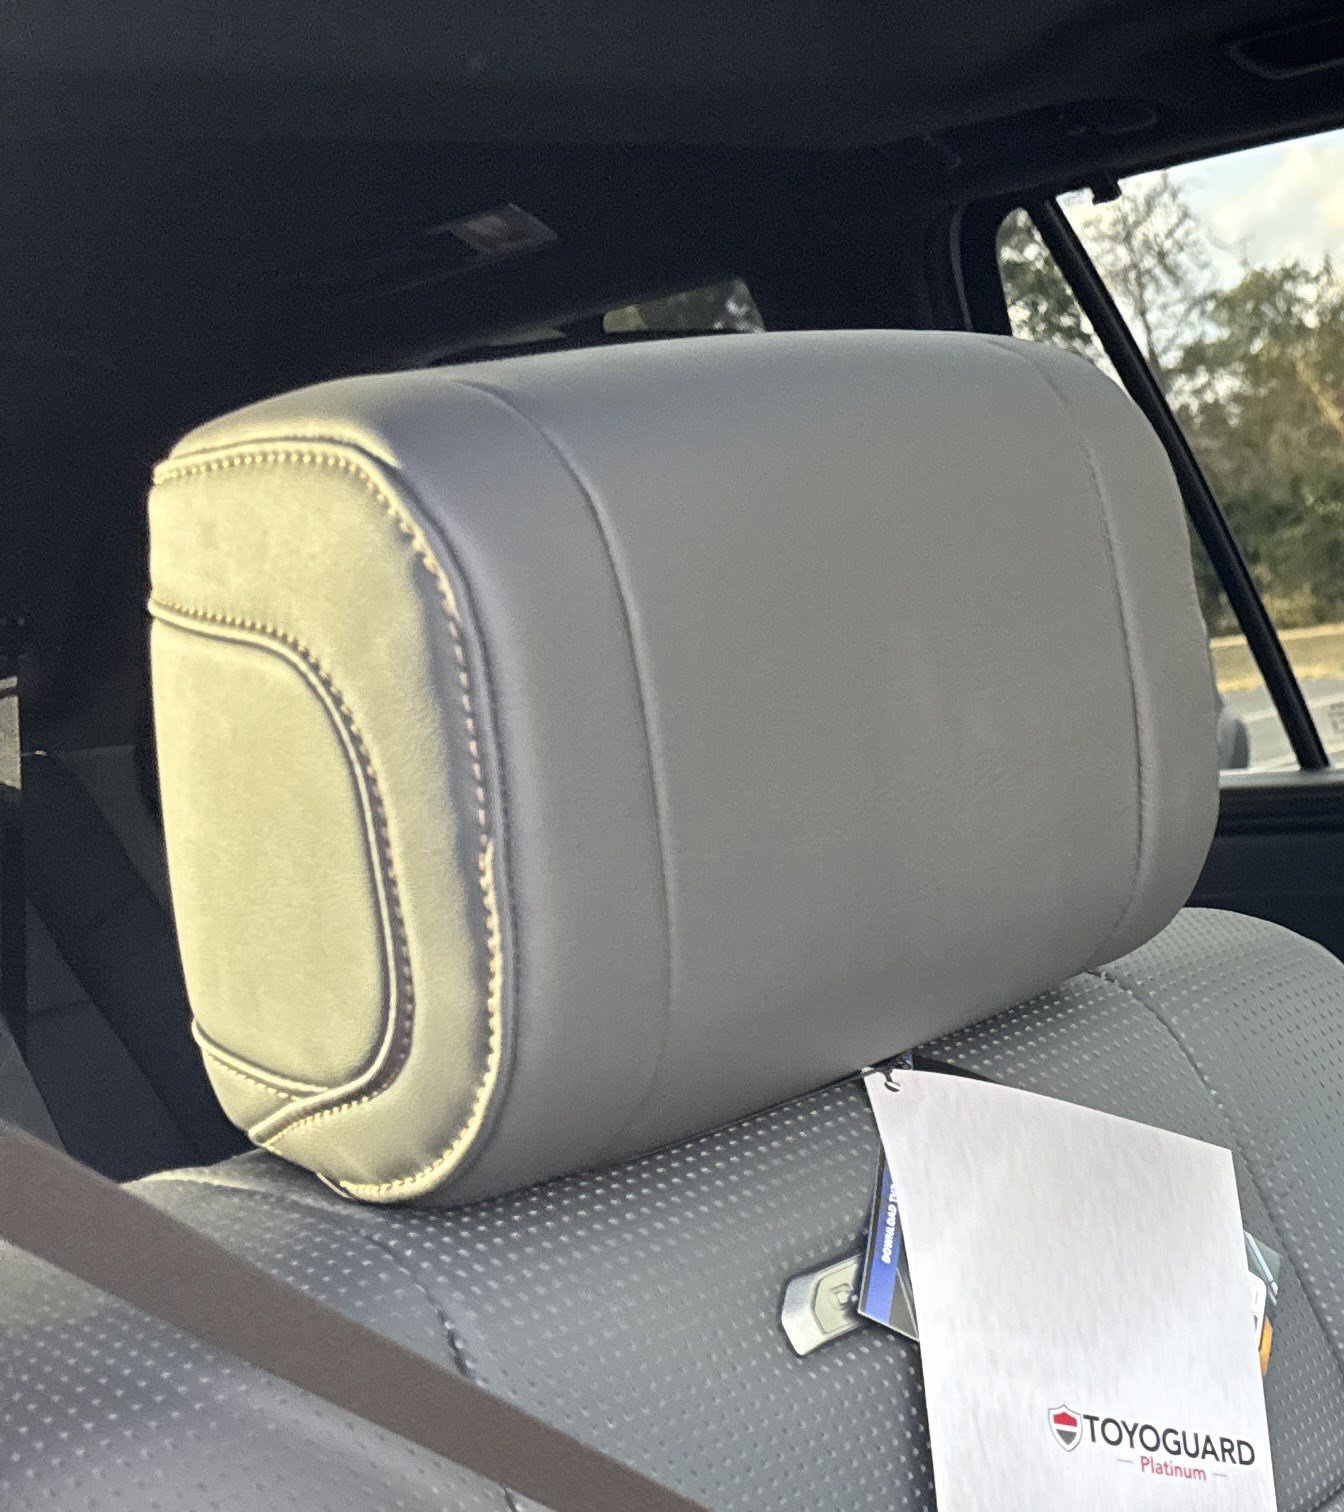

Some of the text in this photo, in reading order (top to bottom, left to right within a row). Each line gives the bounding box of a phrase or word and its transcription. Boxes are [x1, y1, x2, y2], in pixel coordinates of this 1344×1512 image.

[881, 1204, 897, 1264] DOWNLOAD
[1083, 1414, 1256, 1466] TOYOGUARD
[1140, 1455, 1207, 1481] Platinum
